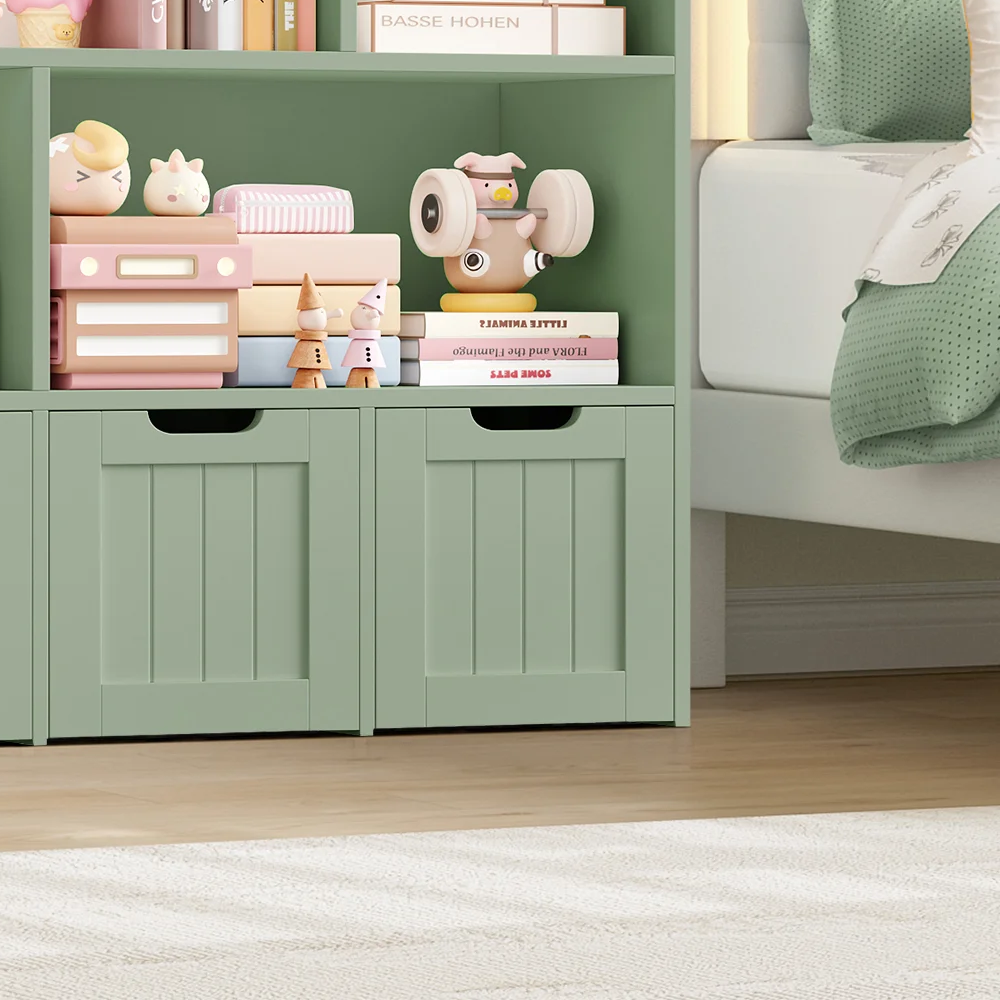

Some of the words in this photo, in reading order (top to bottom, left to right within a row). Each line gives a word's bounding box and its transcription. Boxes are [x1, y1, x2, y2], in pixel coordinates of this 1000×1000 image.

[284, 1, 295, 31] THE
[381, 15, 443, 27] BASSE
[451, 16, 520, 28] HOHEN
[453, 346, 505, 358] Flamingo
[508, 347, 526, 357] the
[529, 347, 550, 357] and
[553, 346, 587, 357] FLORA
[490, 369, 518, 379] PETS
[521, 369, 551, 379] SOME
